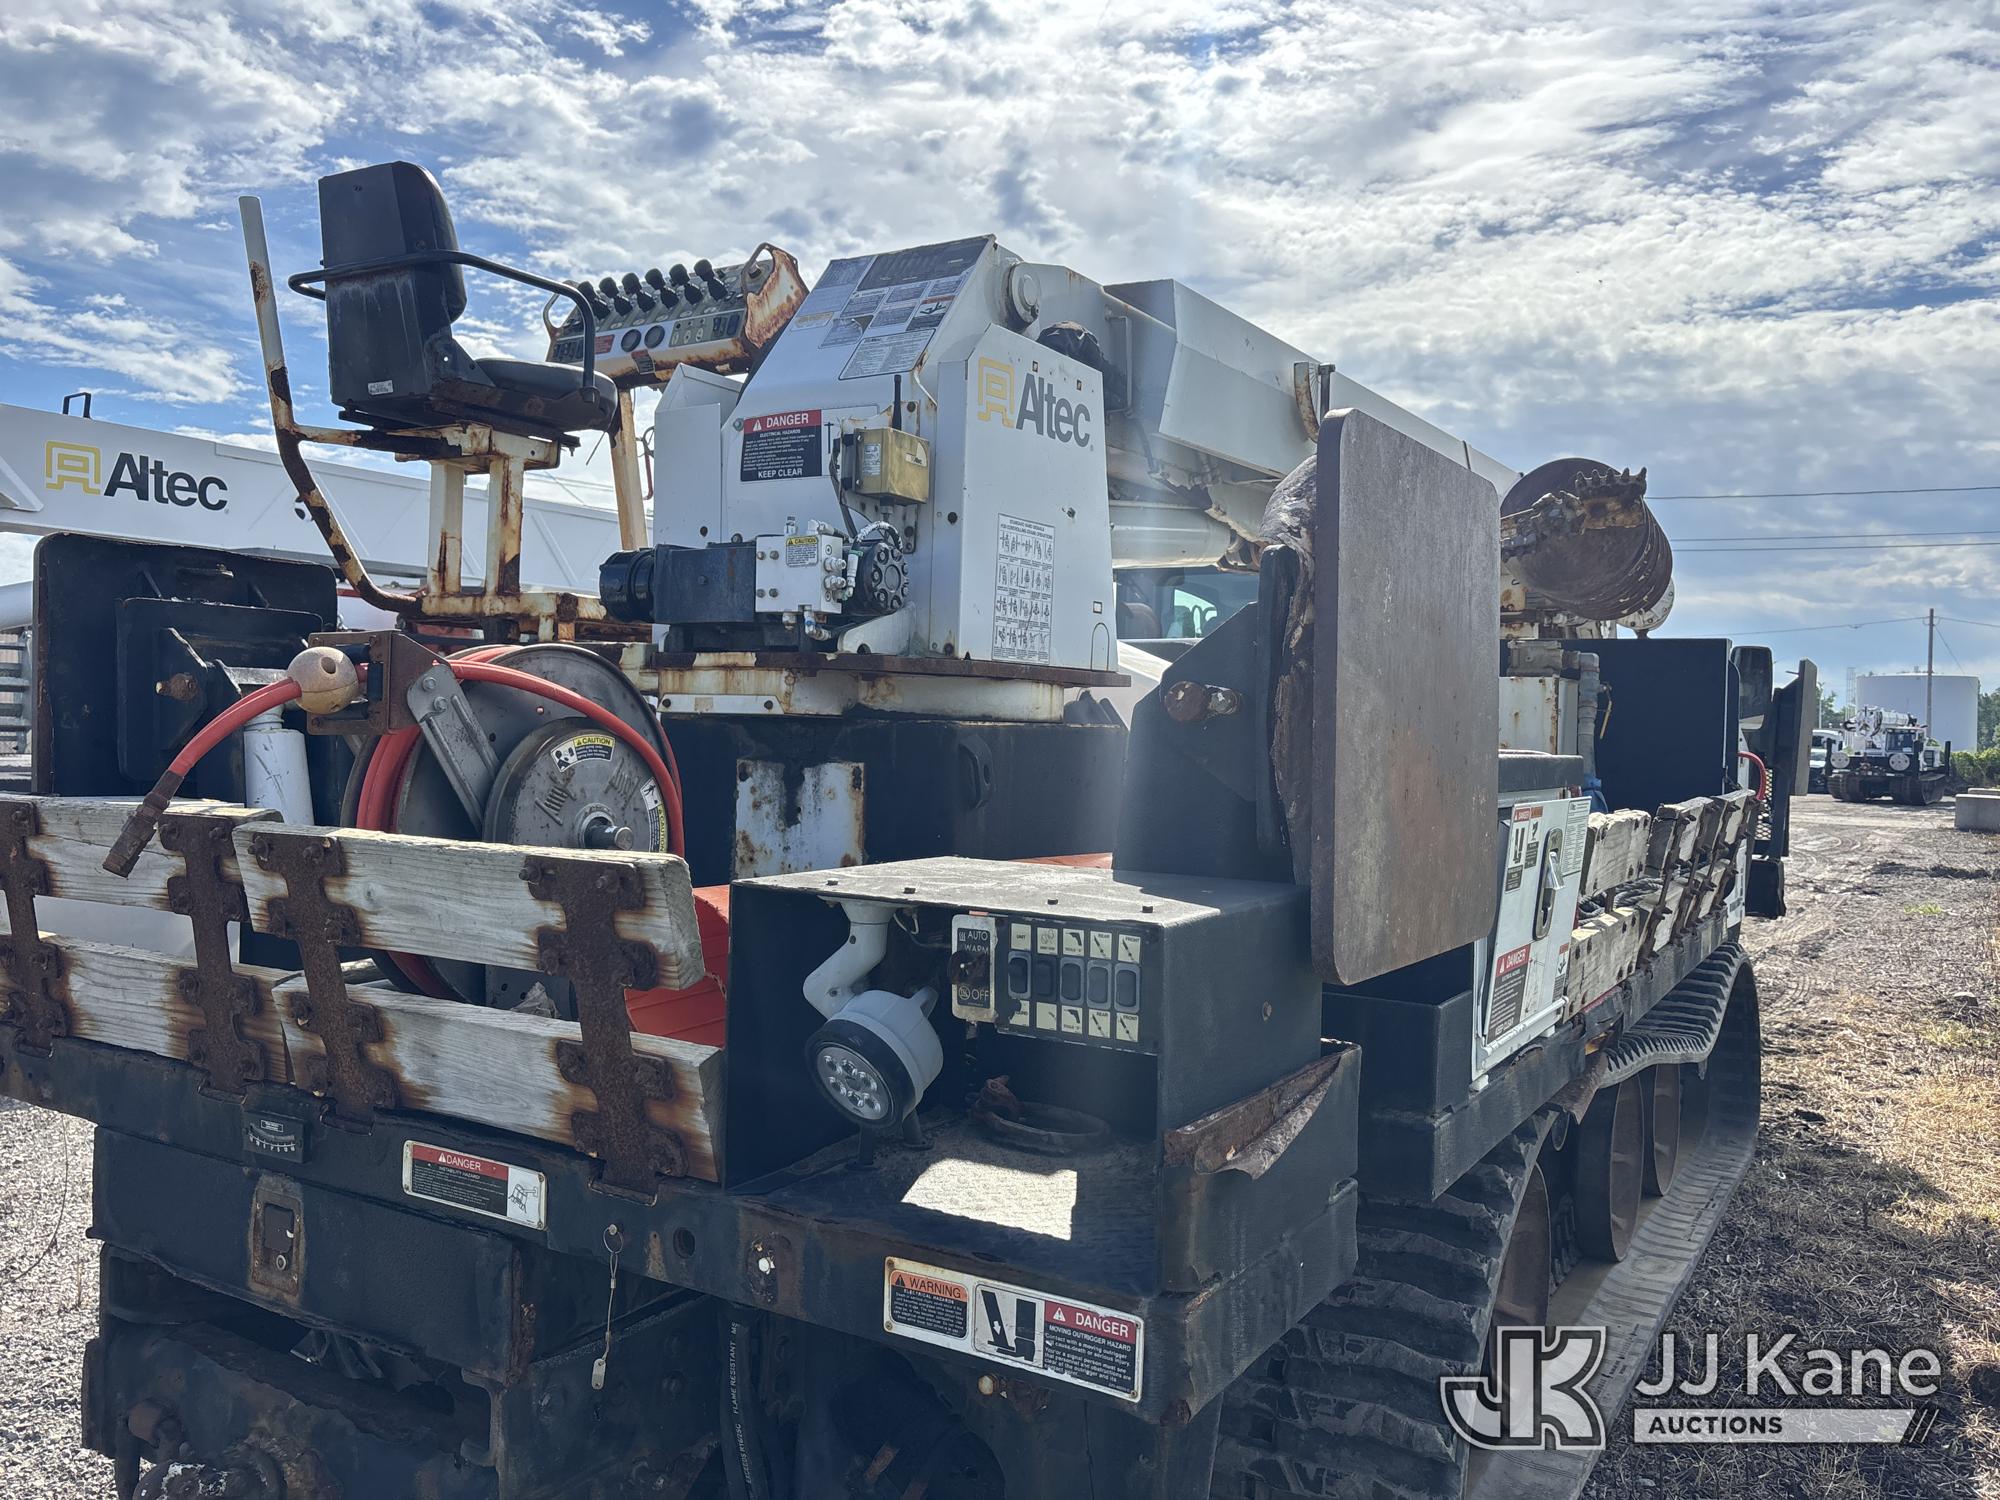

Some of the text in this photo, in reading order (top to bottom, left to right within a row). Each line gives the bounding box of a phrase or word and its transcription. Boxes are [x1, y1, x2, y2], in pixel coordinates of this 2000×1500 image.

[1016, 373, 1091, 447] Altec
[766, 413, 809, 428] DANGER
[104, 452, 228, 511] Altec
[758, 468, 802, 479] KEEP CLEAR
[582, 736, 611, 745] CAUTION
[967, 930, 988, 941] AUTO
[971, 988, 989, 1000] OFF
[446, 1155, 481, 1171] DANGER
[904, 1288, 932, 1299] ELECTRICAL
[910, 1277, 961, 1299] WARNING
[1076, 1312, 1129, 1338] DANGER
[1045, 1332, 1065, 1342] Contact
[1082, 1343, 1101, 1353] moving
[1103, 1348, 1126, 1360] outrigger
[1049, 1324, 1130, 1352] MOVING OUTRIGGER HAZARD
[729, 1341, 737, 1386] RESISTANT
[1083, 1358, 1101, 1367] person
[730, 1387, 739, 1414] FLAME
